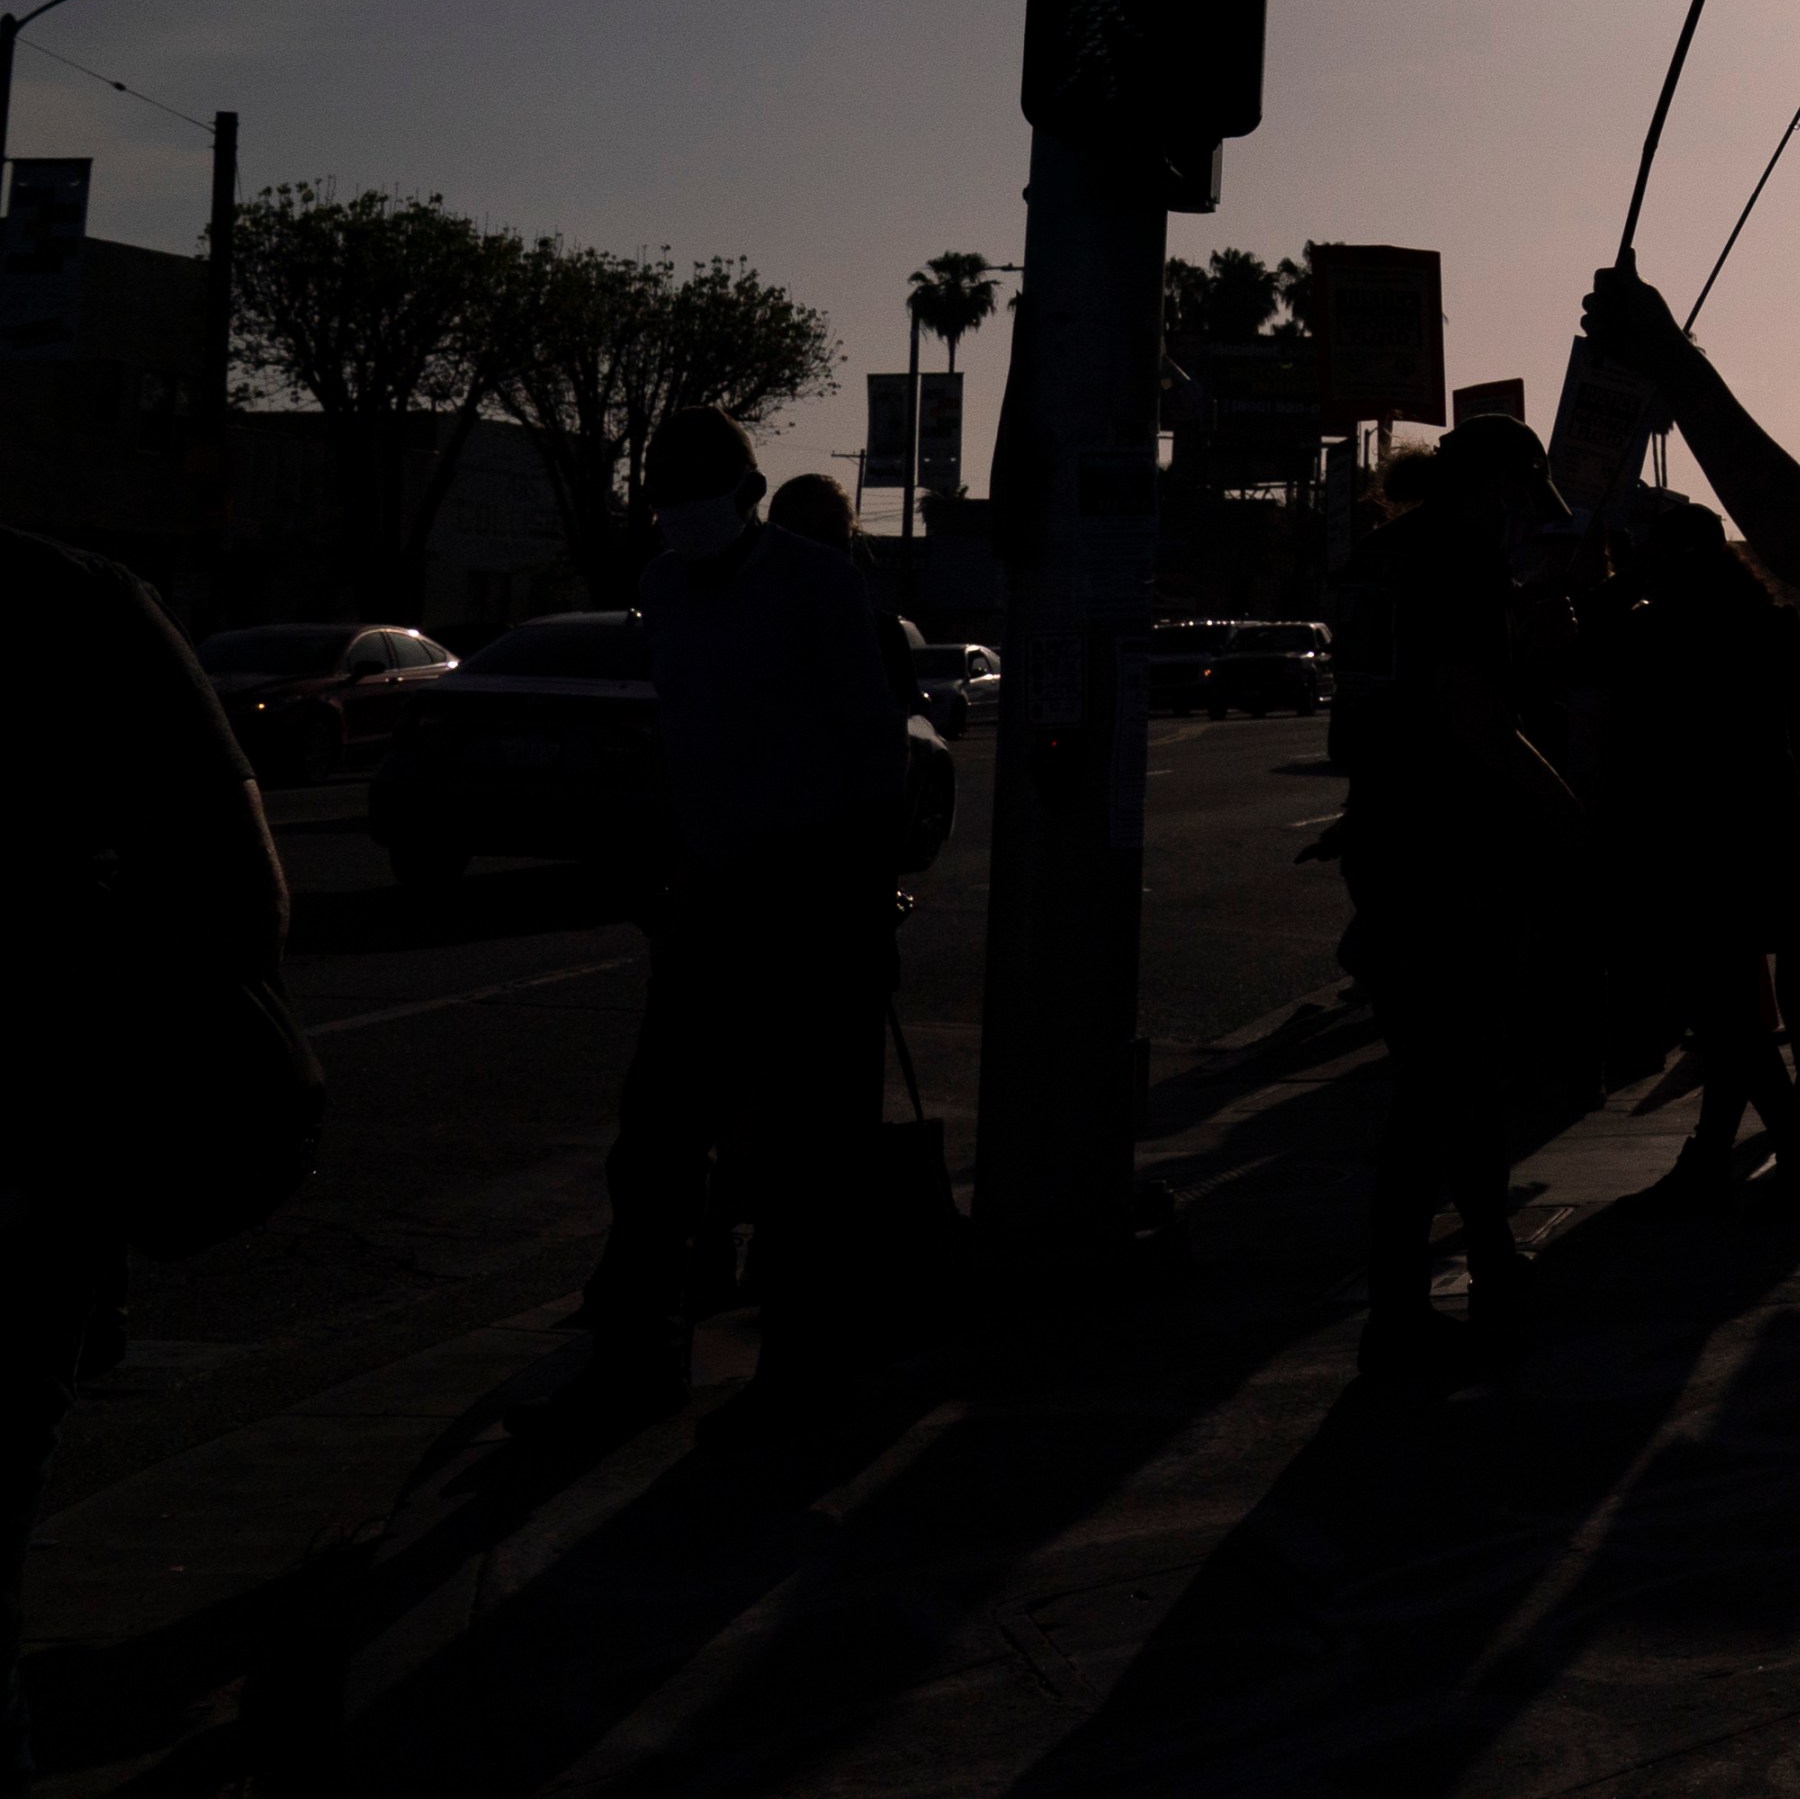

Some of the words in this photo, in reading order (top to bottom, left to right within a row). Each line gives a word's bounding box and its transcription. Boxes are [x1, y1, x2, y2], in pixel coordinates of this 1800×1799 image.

[1341, 291, 1417, 309] JUSTICE
[1342, 317, 1419, 331] GEORGE
[1580, 384, 1638, 413] JUSTICE
[1575, 411, 1636, 436] GEORGE
[1577, 426, 1624, 448] FLOYD
